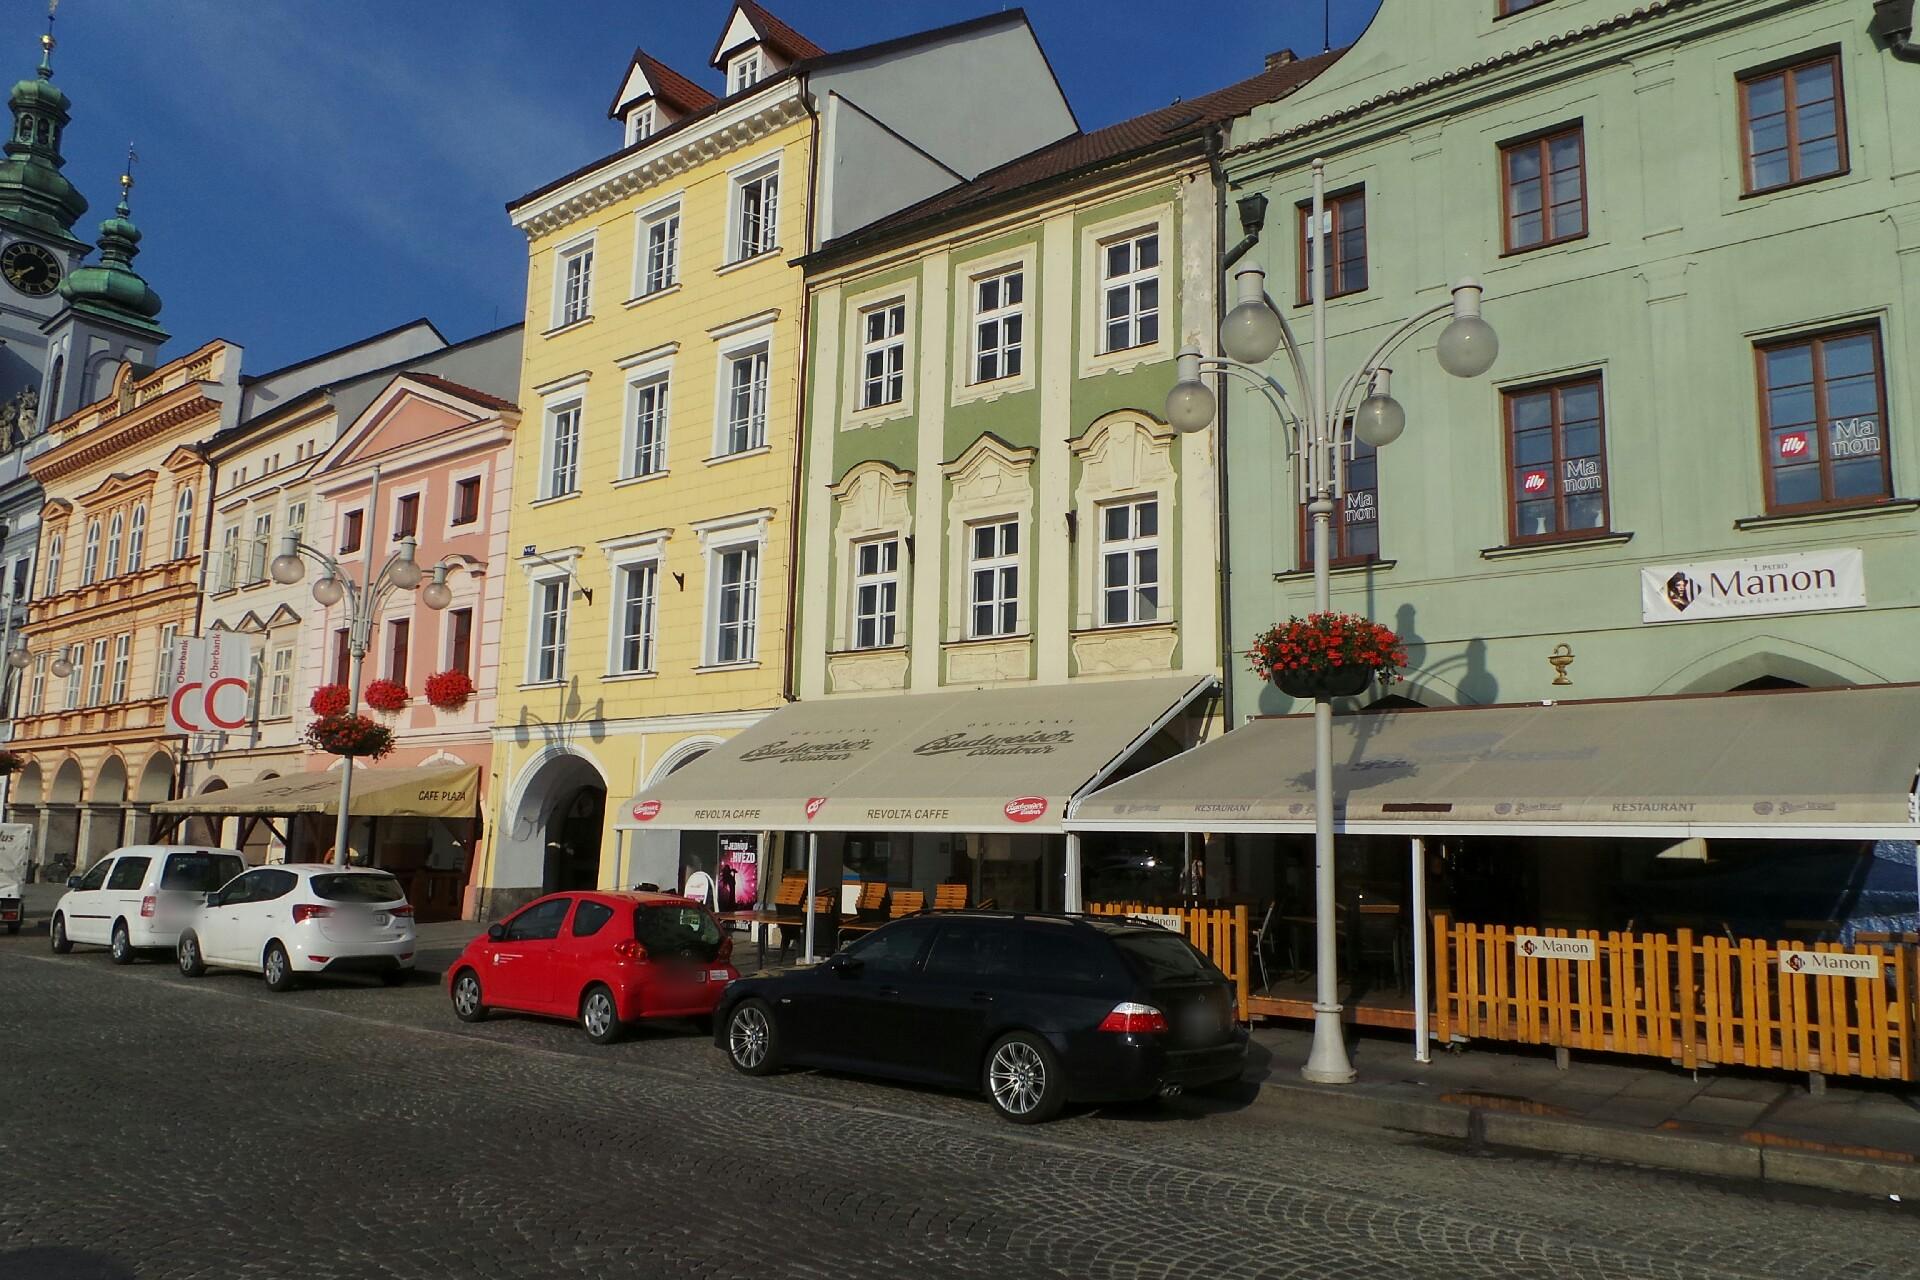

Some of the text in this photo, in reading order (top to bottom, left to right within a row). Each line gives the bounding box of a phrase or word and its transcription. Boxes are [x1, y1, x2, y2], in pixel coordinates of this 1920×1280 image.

[1836, 418, 1875, 438] Ma
[1782, 438, 1806, 453] illy
[1832, 437, 1881, 456] non
[1567, 459, 1598, 477] Ma
[1525, 475, 1545, 490] illy
[1563, 476, 1601, 492] non
[1347, 492, 1373, 508] Ma
[1345, 507, 1376, 521] non
[1710, 568, 1836, 597] Manon
[176, 640, 188, 684] Oberbank
[209, 633, 221, 679] Oberbank
[418, 790, 466, 801] CAFE PLAZA
[694, 809, 760, 819] REVOLTA CAFFE
[867, 809, 949, 819] REVOLTA CAFFE
[1194, 804, 1252, 812] RESTAURANT
[1612, 803, 1697, 812] RESTAURANT
[1542, 940, 1588, 953] Manon
[1812, 955, 1870, 970] Manon
